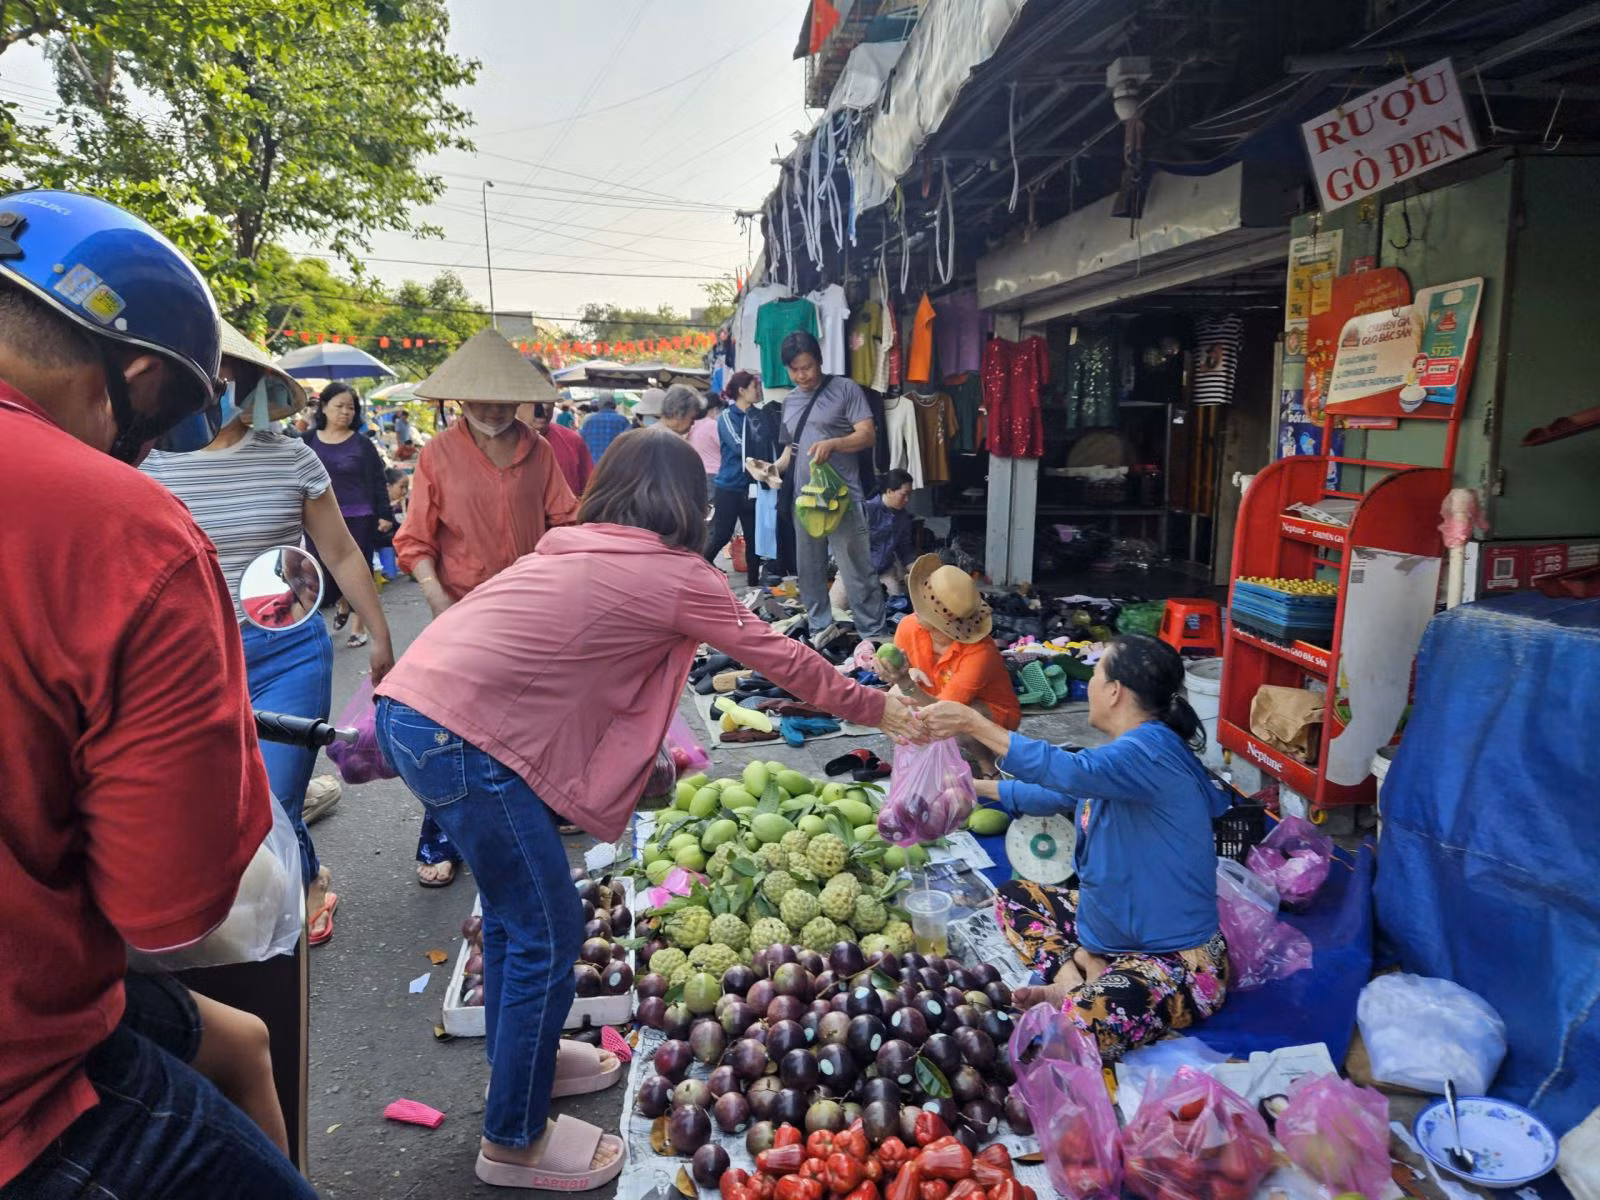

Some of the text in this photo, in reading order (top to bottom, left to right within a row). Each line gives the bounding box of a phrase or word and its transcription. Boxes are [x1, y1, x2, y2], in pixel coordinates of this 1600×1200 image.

[1312, 70, 1448, 153] RƯỢU
[1326, 117, 1469, 203] GÒ ĐEN
[1247, 742, 1282, 771] Neptune
